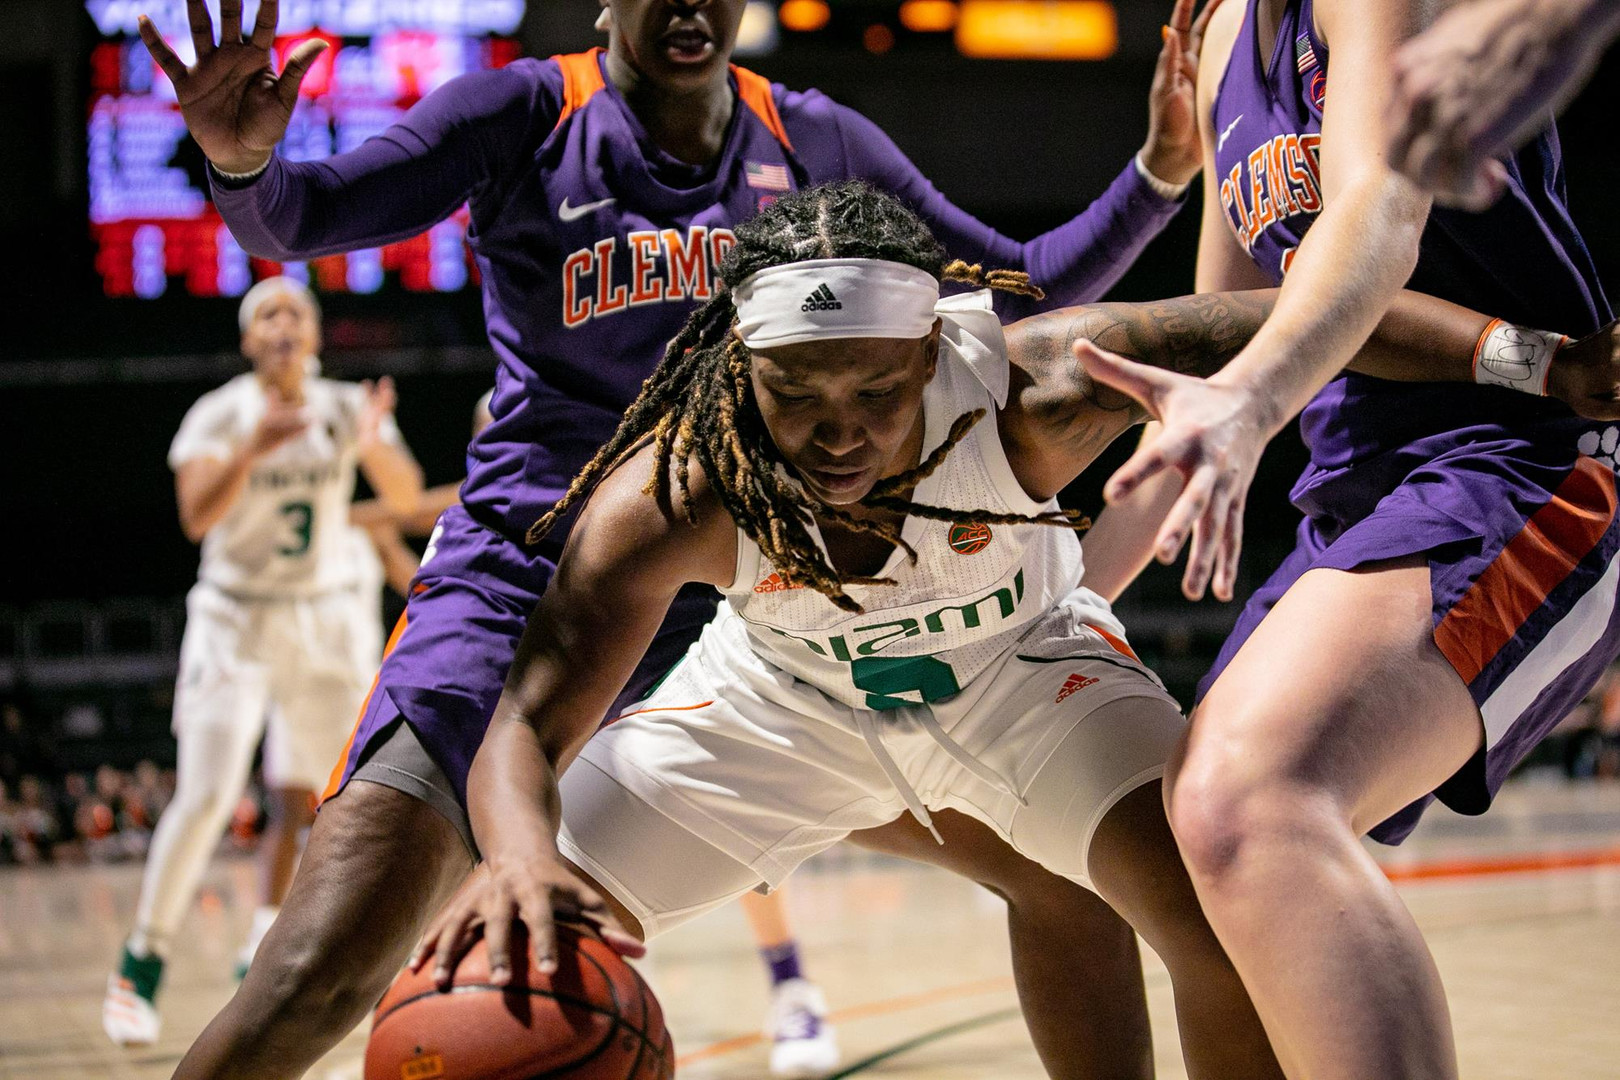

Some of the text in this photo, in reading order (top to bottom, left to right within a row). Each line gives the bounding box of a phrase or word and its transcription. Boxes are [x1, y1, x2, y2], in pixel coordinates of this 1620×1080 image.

[801, 300, 842, 312] adidas
[278, 502, 314, 557] 3
[956, 529, 987, 541] ACC
[1055, 677, 1100, 703] adidas
